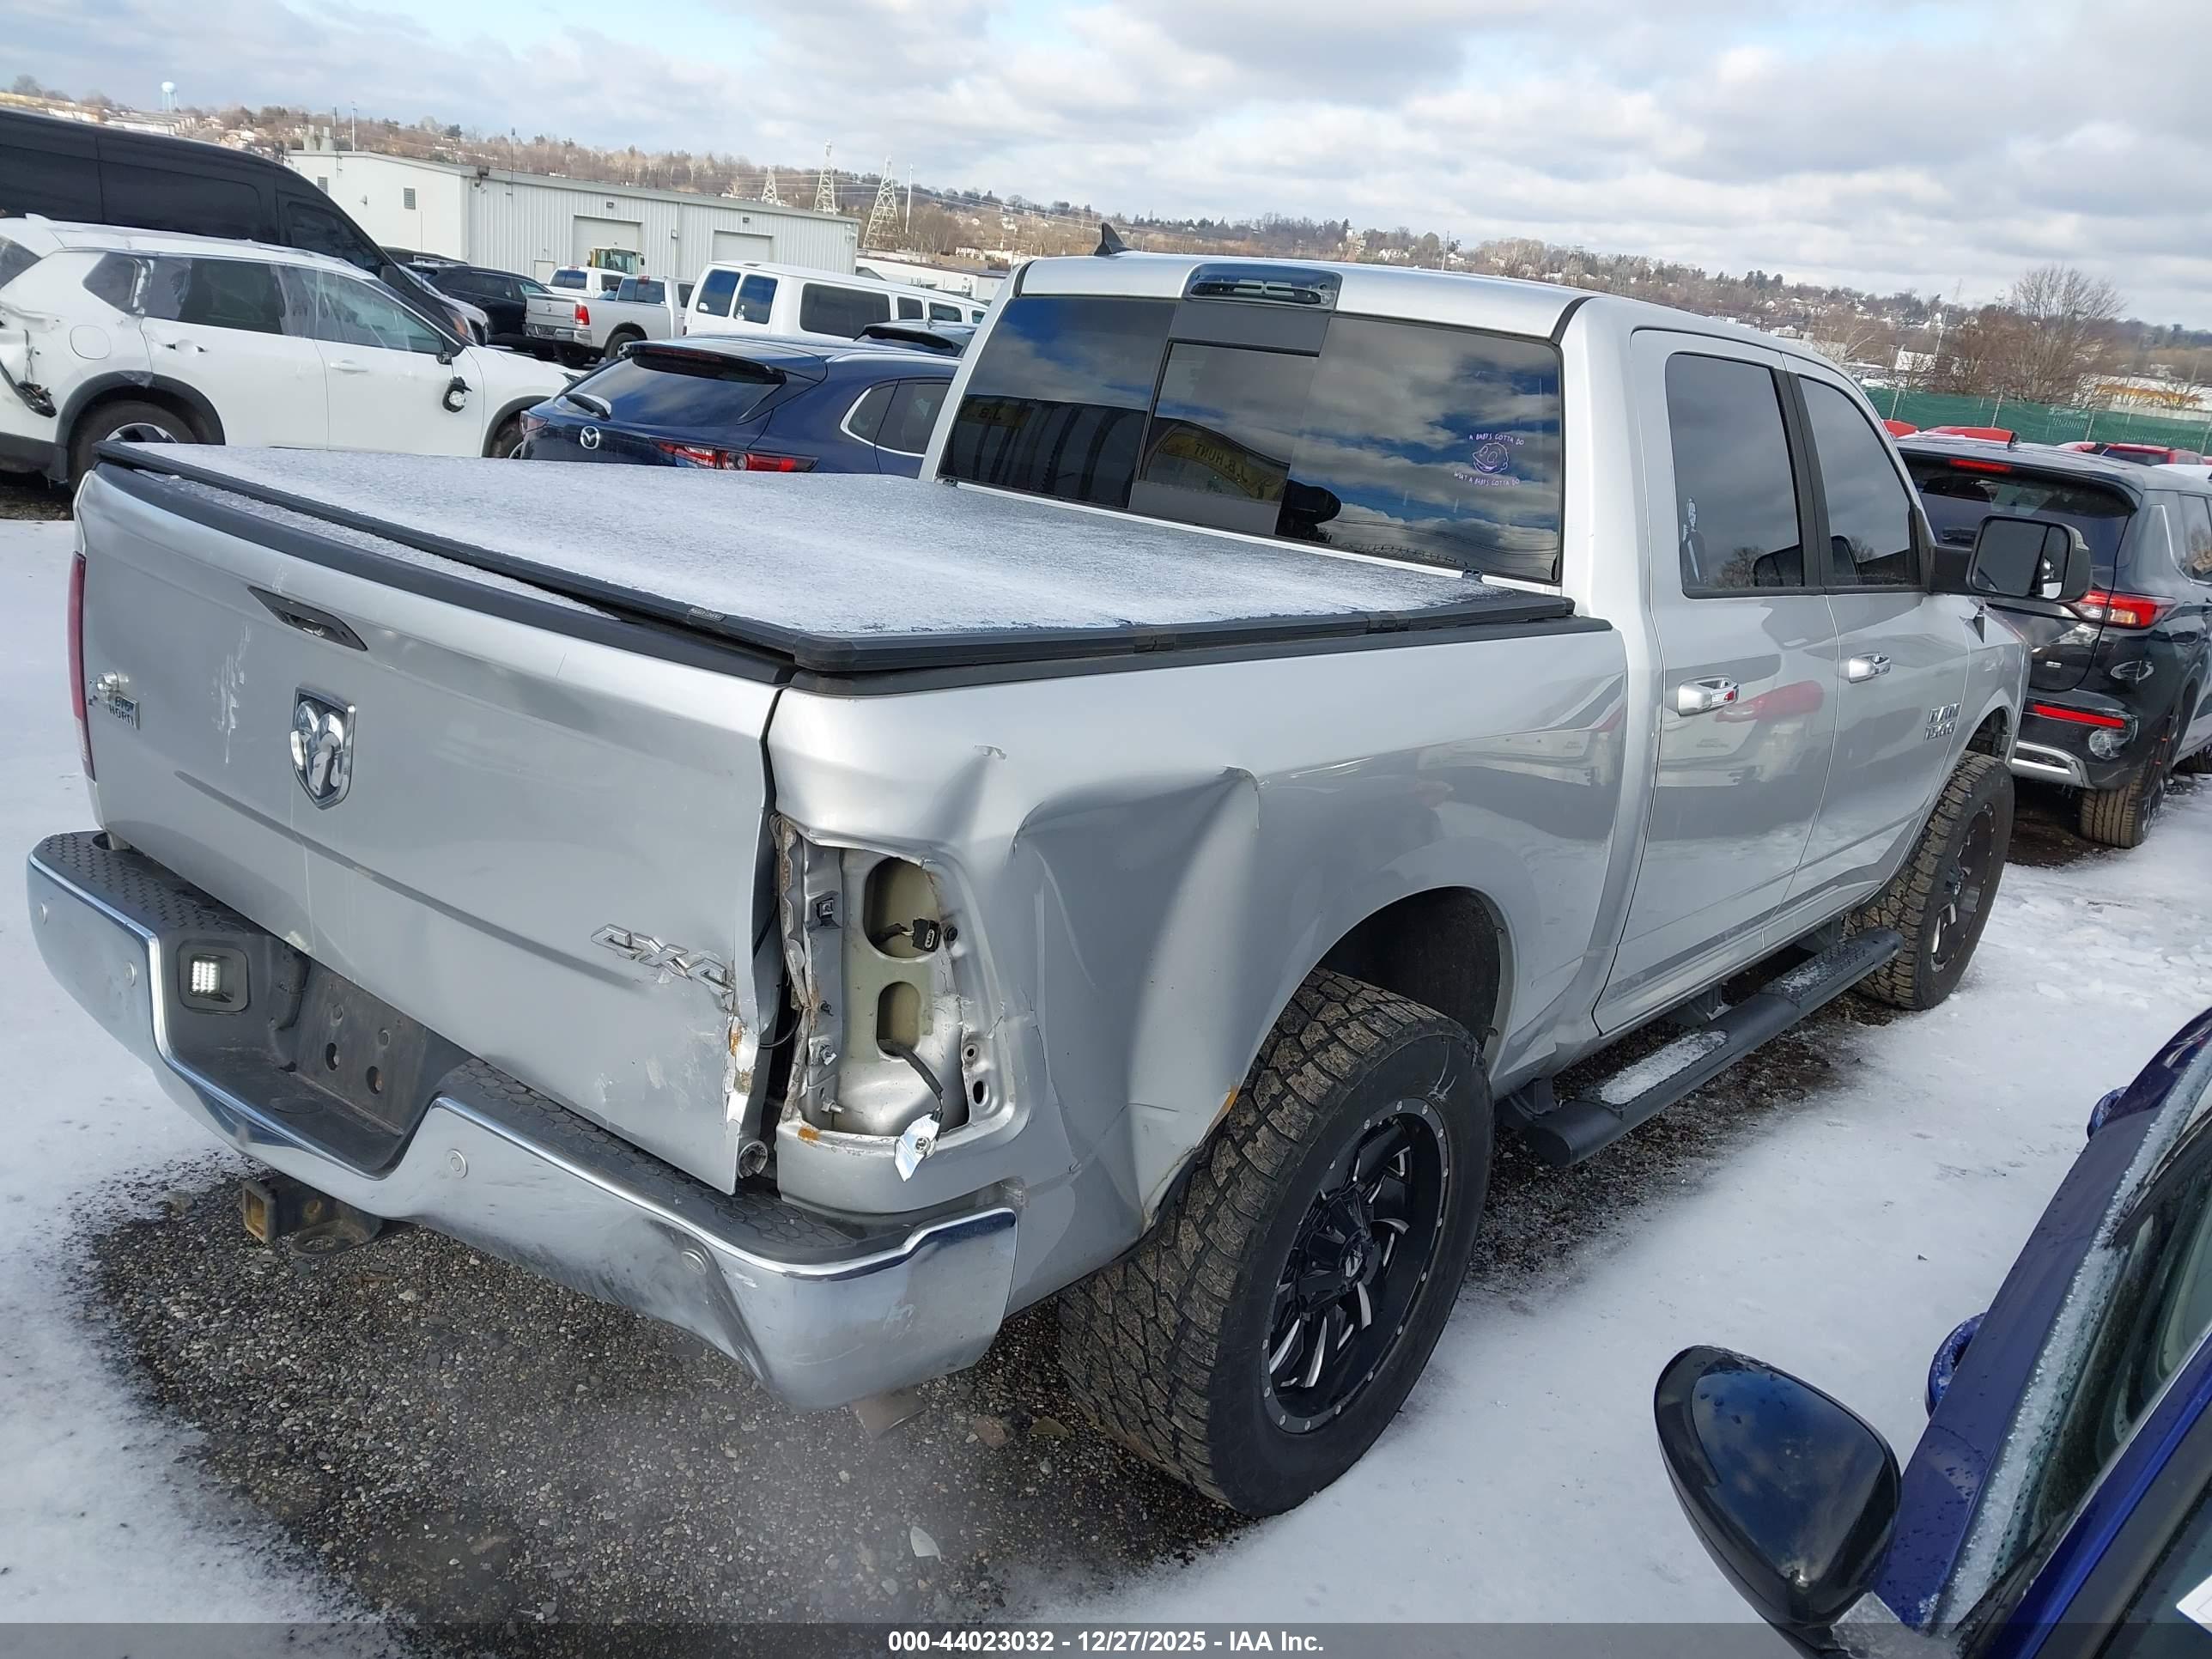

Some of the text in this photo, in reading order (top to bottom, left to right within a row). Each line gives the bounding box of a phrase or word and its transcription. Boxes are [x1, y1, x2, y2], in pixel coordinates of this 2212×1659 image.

[1494, 433, 1514, 444] GOTTA
[1516, 437, 1525, 446] DO
[1511, 477, 1521, 486] DO
[114, 696, 135, 712] BIG
[108, 703, 135, 726] HORN
[1928, 702, 1960, 723] RAM
